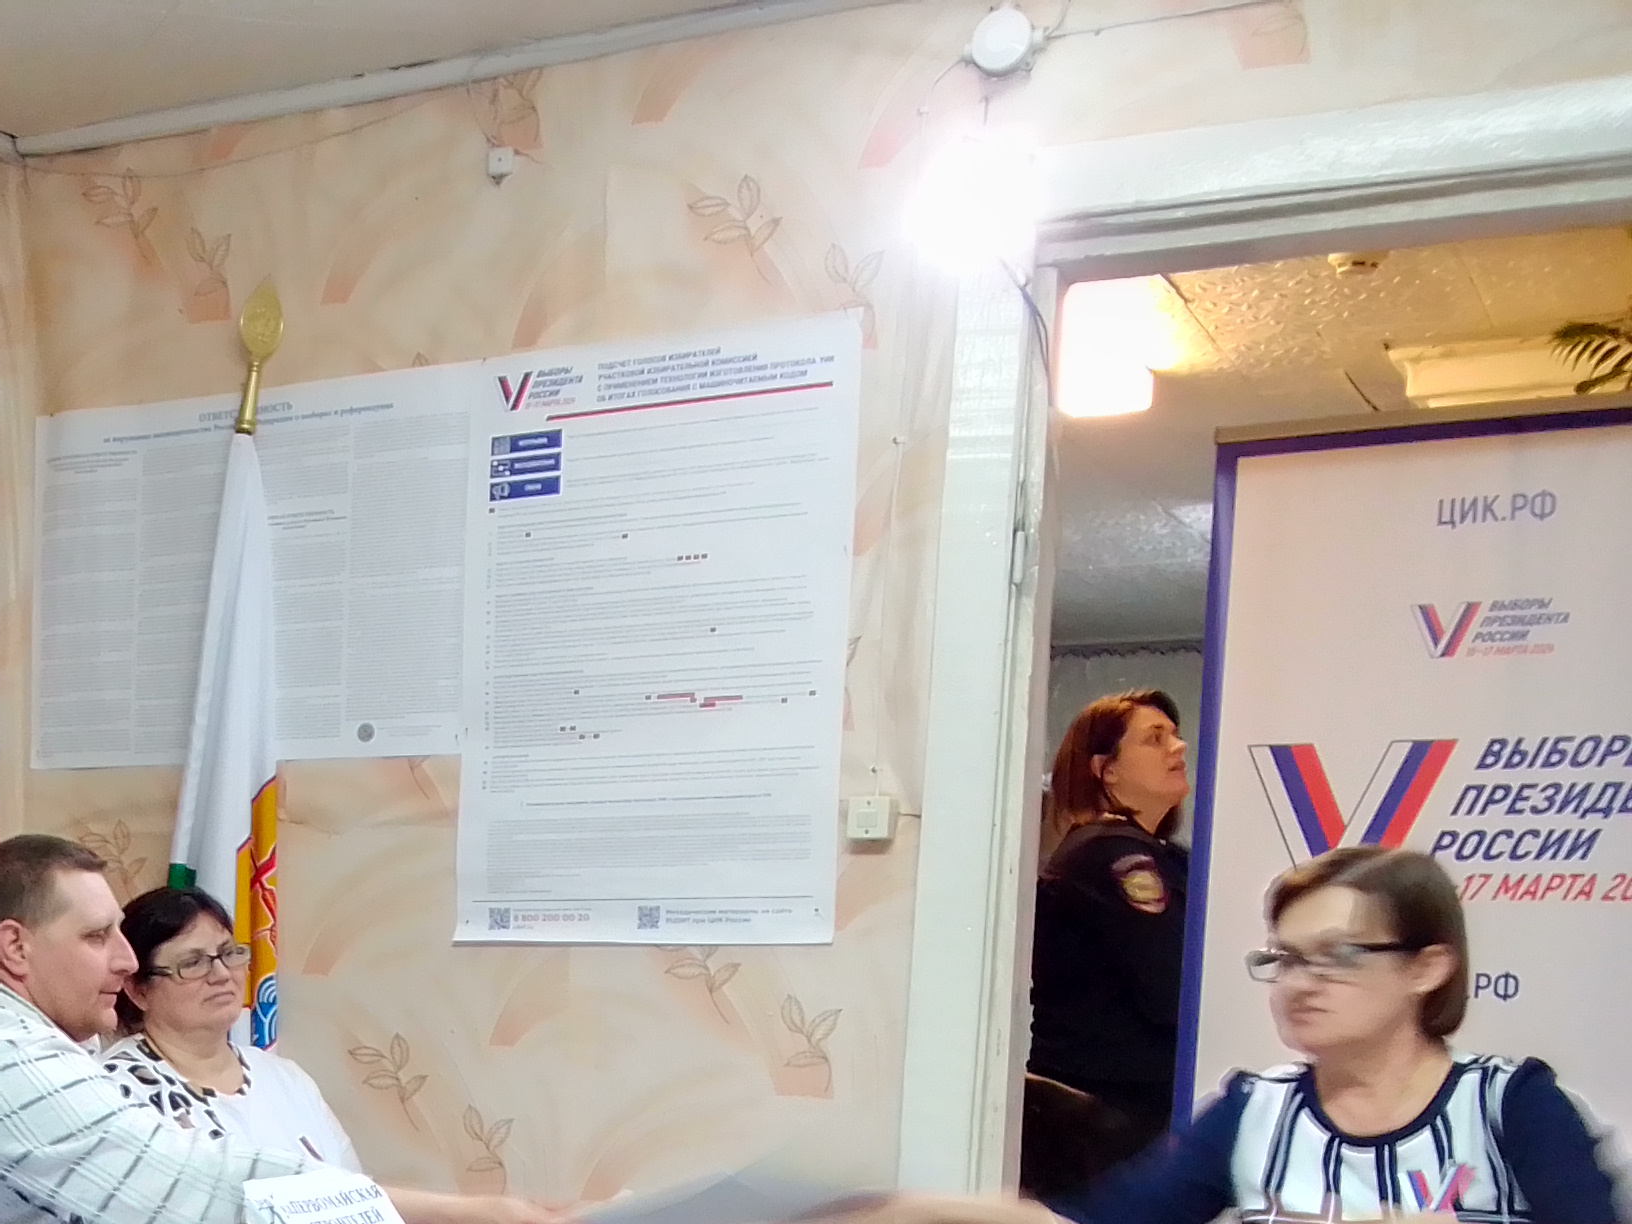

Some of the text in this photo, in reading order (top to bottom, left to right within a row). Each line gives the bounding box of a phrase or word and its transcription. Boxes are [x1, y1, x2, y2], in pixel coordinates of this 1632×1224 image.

[198, 401, 293, 423] ОТВЕТСНОСТЬ
[1437, 488, 1558, 530] ЦИК.РФ
[1488, 598, 1554, 612] ВЫБОРЫ
[1479, 612, 1571, 628] ПРЕЗИДЕНТА
[1471, 629, 1531, 643] РОССИИ
[1474, 734, 1632, 770] ВЫБОР
[1429, 827, 1604, 861] РОССИИ
[1491, 873, 1599, 901] МАРТА
